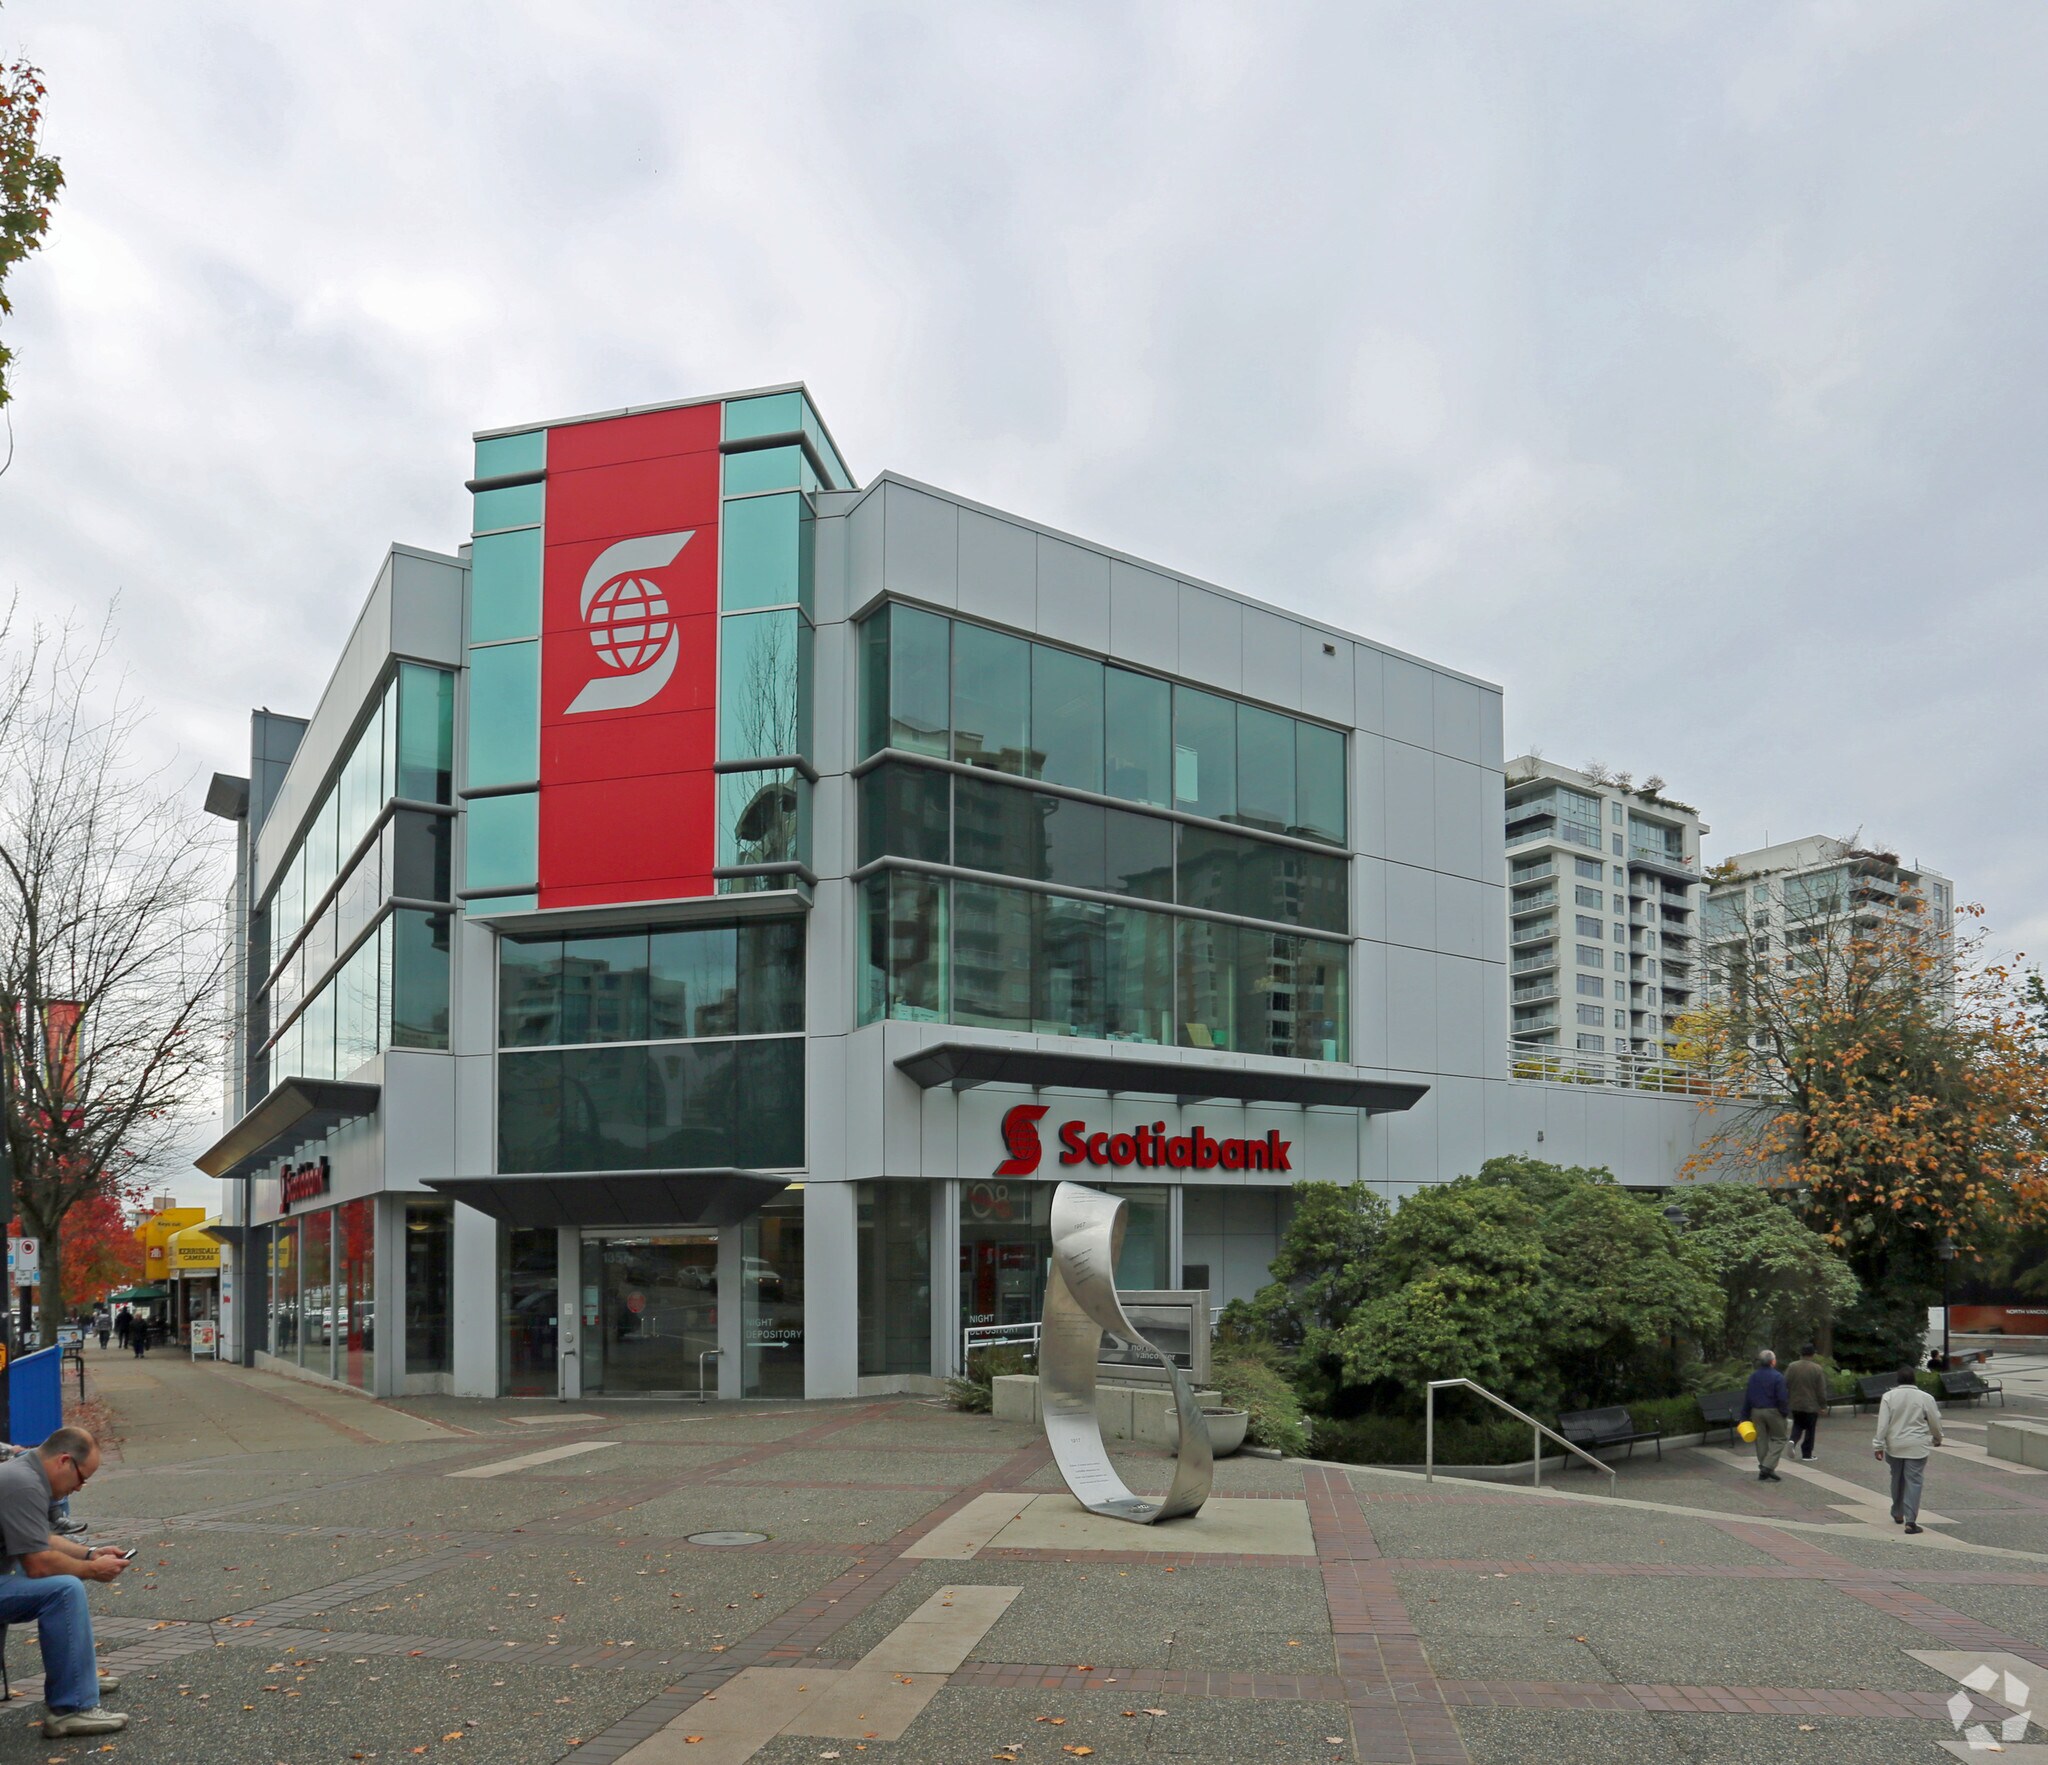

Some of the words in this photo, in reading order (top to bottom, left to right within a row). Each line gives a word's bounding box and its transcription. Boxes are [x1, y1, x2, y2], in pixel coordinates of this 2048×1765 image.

[1060, 1120, 1292, 1171] Scotiabank
[178, 1247, 219, 1255] KERRISDALE
[746, 1318, 773, 1327] NIGHT
[969, 1314, 994, 1323] NIGHT
[746, 1330, 802, 1339] DEPOSITORY
[1131, 1344, 1152, 1352] nor
[1135, 1352, 1176, 1361] vancoer
